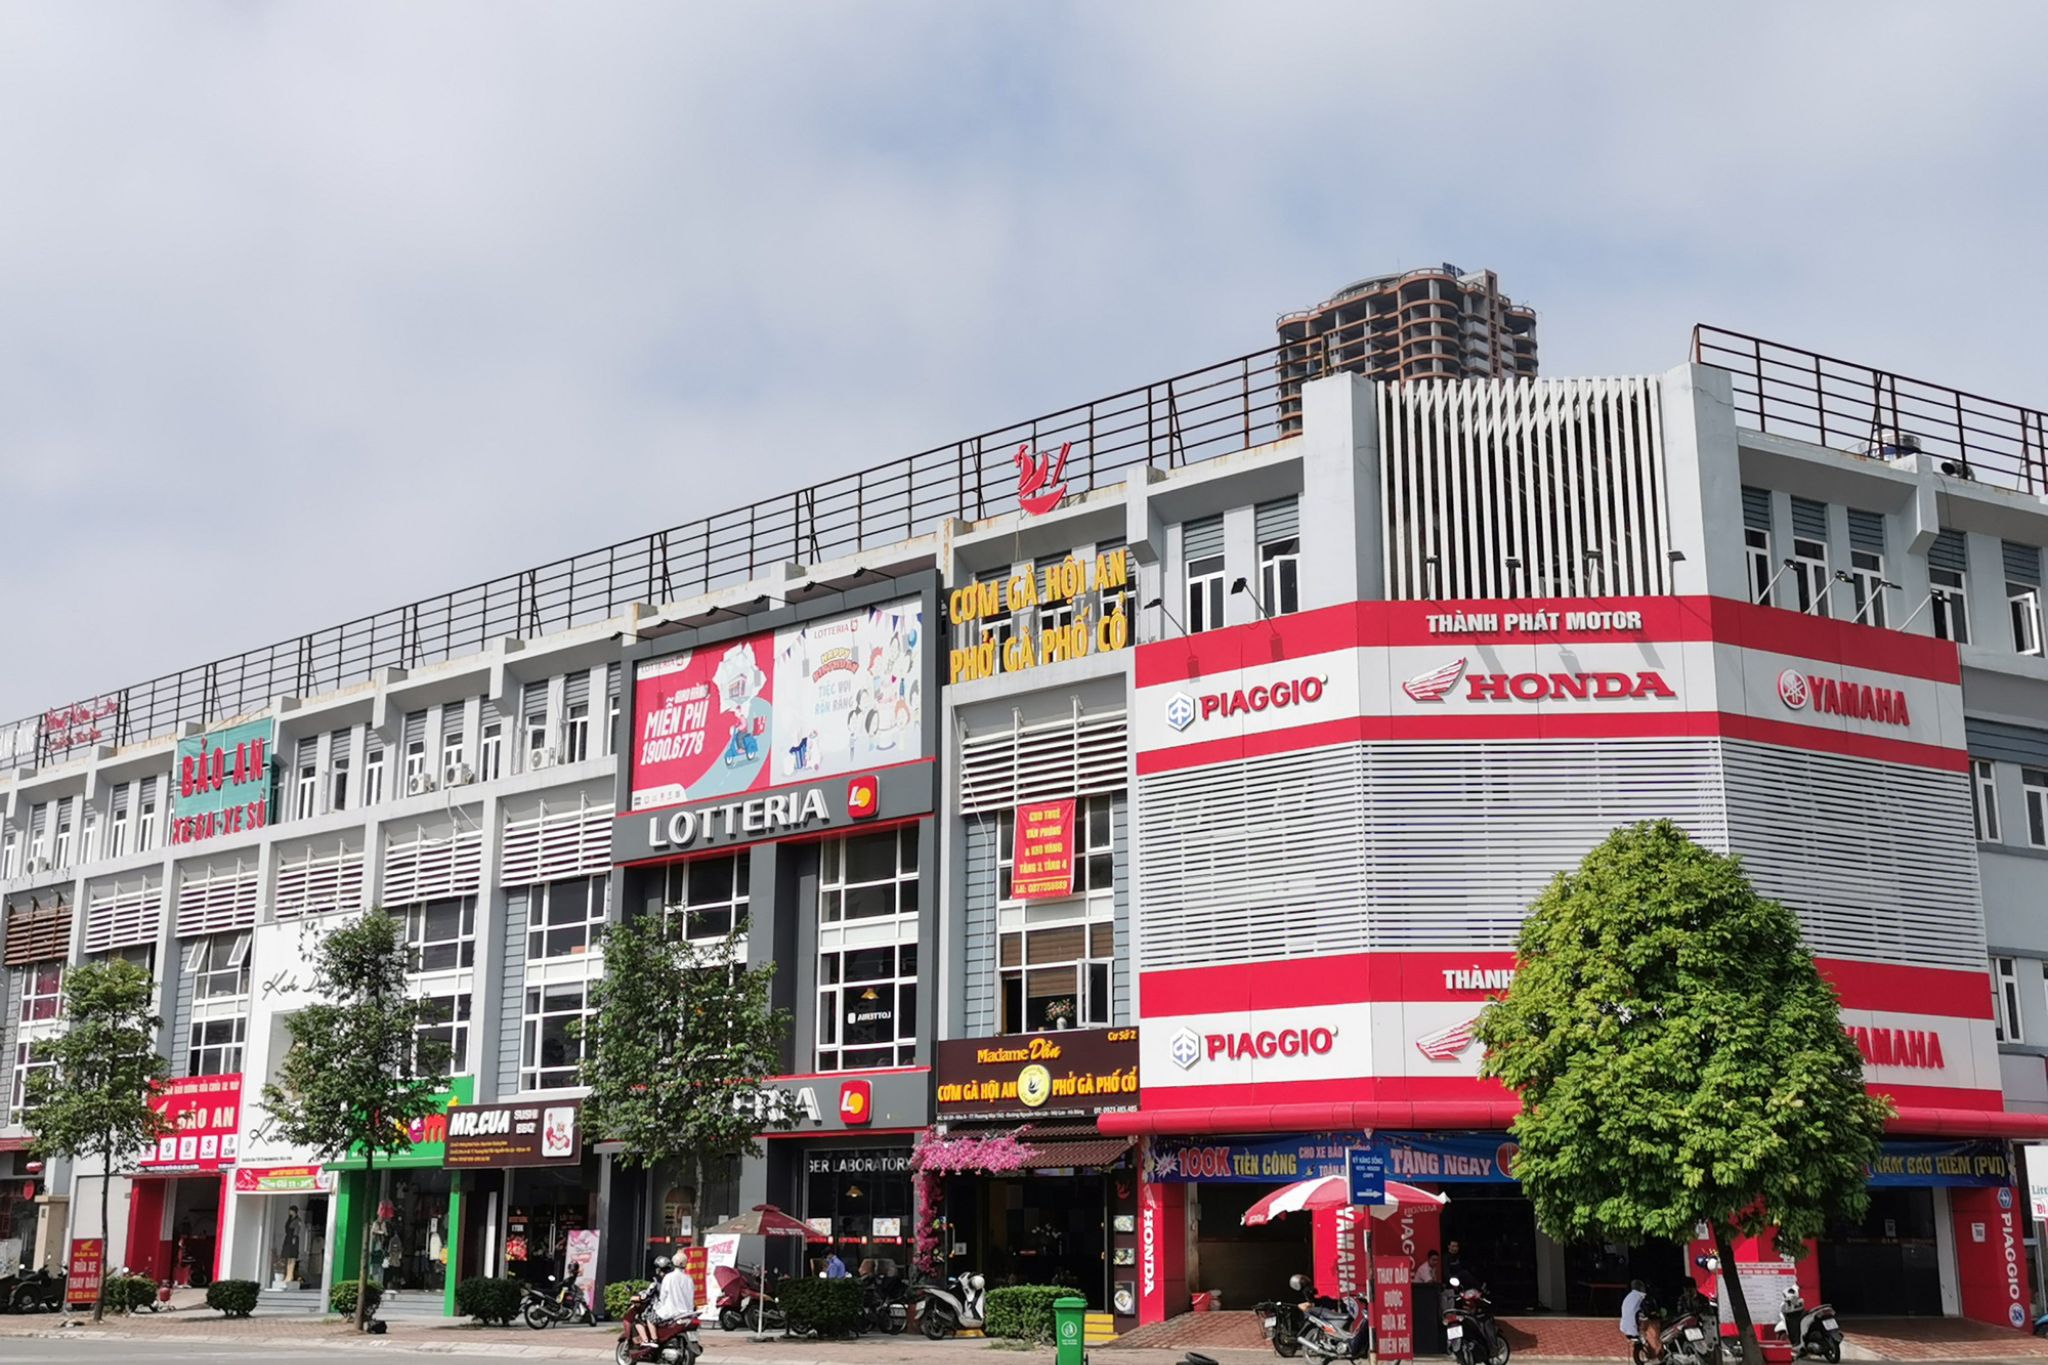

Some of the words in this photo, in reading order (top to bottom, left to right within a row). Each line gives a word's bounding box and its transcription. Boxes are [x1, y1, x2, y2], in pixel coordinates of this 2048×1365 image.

[950, 580, 999, 625] CƠM
[1005, 563, 1039, 611] GÀ
[1044, 554, 1086, 604] HỘI
[1092, 547, 1128, 592] AN
[814, 623, 849, 640] LOTTERIA
[950, 630, 996, 685] PHỞ
[1003, 627, 1036, 673] GÀ
[1041, 606, 1089, 664] PHỐ
[1097, 591, 1129, 653] CỔ
[1426, 609, 1498, 634] THÀNH
[1504, 606, 1562, 632] PHÁT
[1567, 608, 1642, 631] MOTOR
[1199, 675, 1323, 720] PIAGGIO
[1466, 671, 1675, 701] HONDA
[1808, 676, 1909, 726] YAMAHA
[644, 696, 682, 740] MIỄN
[681, 693, 711, 733] PHÍ
[640, 729, 706, 766] 1900.6778
[181, 736, 225, 799] BẢO
[232, 736, 265, 787] AN
[223, 805, 243, 836] XE
[649, 788, 830, 848] LOTTERIA
[1441, 965, 1516, 991] THÀNH
[977, 1047, 1029, 1064] Madame
[1205, 1026, 1334, 1061] PIAGGIO
[938, 1084, 962, 1103] CƠM
[963, 1079, 980, 1101] GÀ
[981, 1078, 999, 1104] HỘI
[1001, 1081, 1018, 1099] AN
[1052, 1070, 1077, 1096] PHỞ
[1077, 1072, 1095, 1096] GÀ
[1096, 1067, 1123, 1094] PHỐ
[1121, 1065, 1138, 1093] CỔ
[211, 1106, 235, 1128] AN
[448, 1109, 512, 1137] MR.CUA
[1178, 1146, 1232, 1178] 100K
[1262, 1151, 1297, 1176] CÔNG
[1298, 1146, 1315, 1159] CHO
[1316, 1146, 1327, 1159] XE
[1390, 1145, 1440, 1179] TẶNG
[1443, 1154, 1492, 1177] NGAY
[1142, 1208, 1155, 1297] HONDA
[1335, 1206, 1357, 1293] YAMAHA
[2001, 1212, 2020, 1300] PIAGGIO
[1376, 1267, 1393, 1284] THAY
[1397, 1313, 1406, 1331] XE
